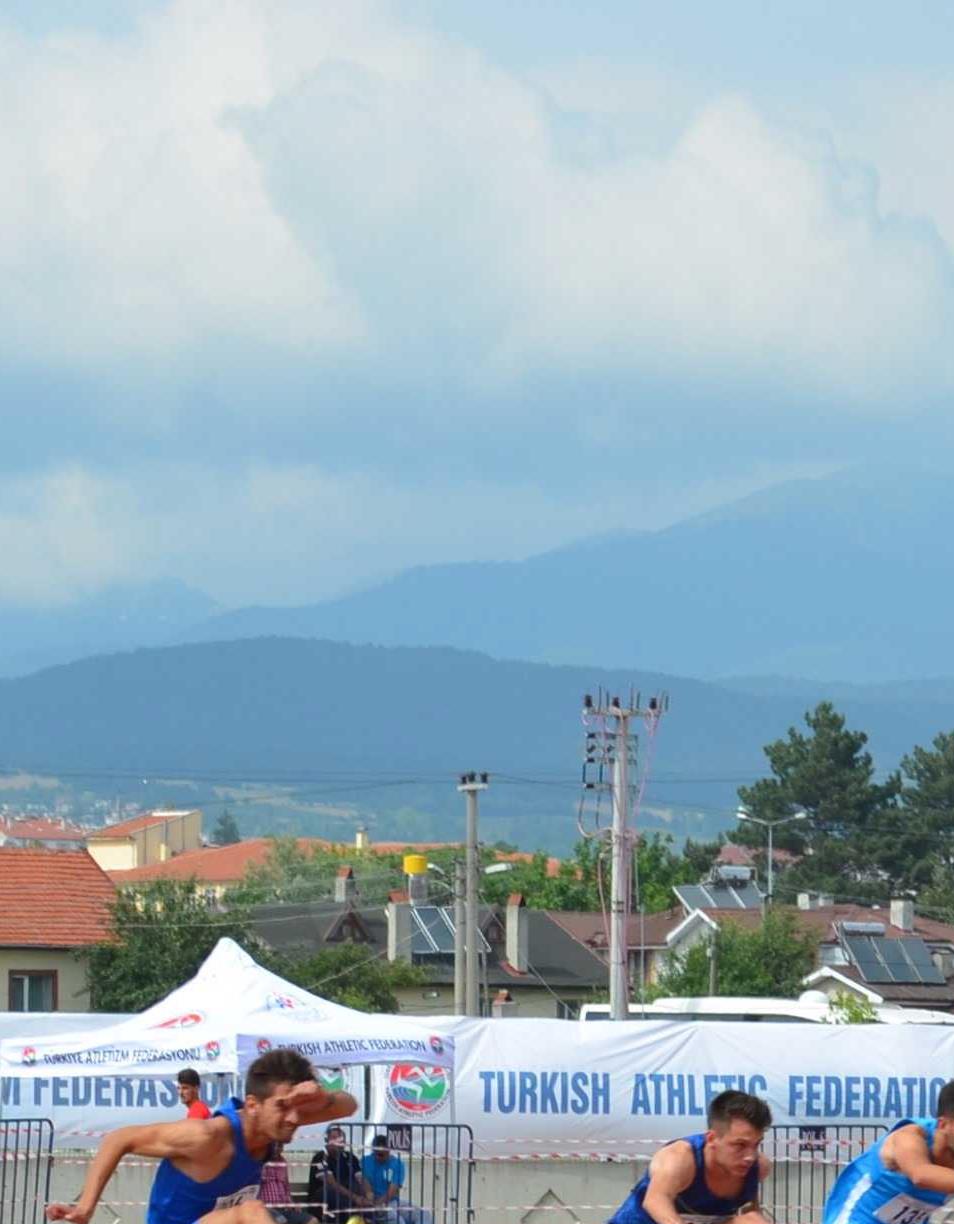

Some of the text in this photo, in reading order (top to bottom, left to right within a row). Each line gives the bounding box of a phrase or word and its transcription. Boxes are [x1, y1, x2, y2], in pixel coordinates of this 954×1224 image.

[277, 1042, 322, 1056] KISH
[323, 1039, 368, 1054] ATHLETIC
[480, 1072, 610, 1115] TURKISH
[788, 1075, 946, 1119] FEDERATIO
